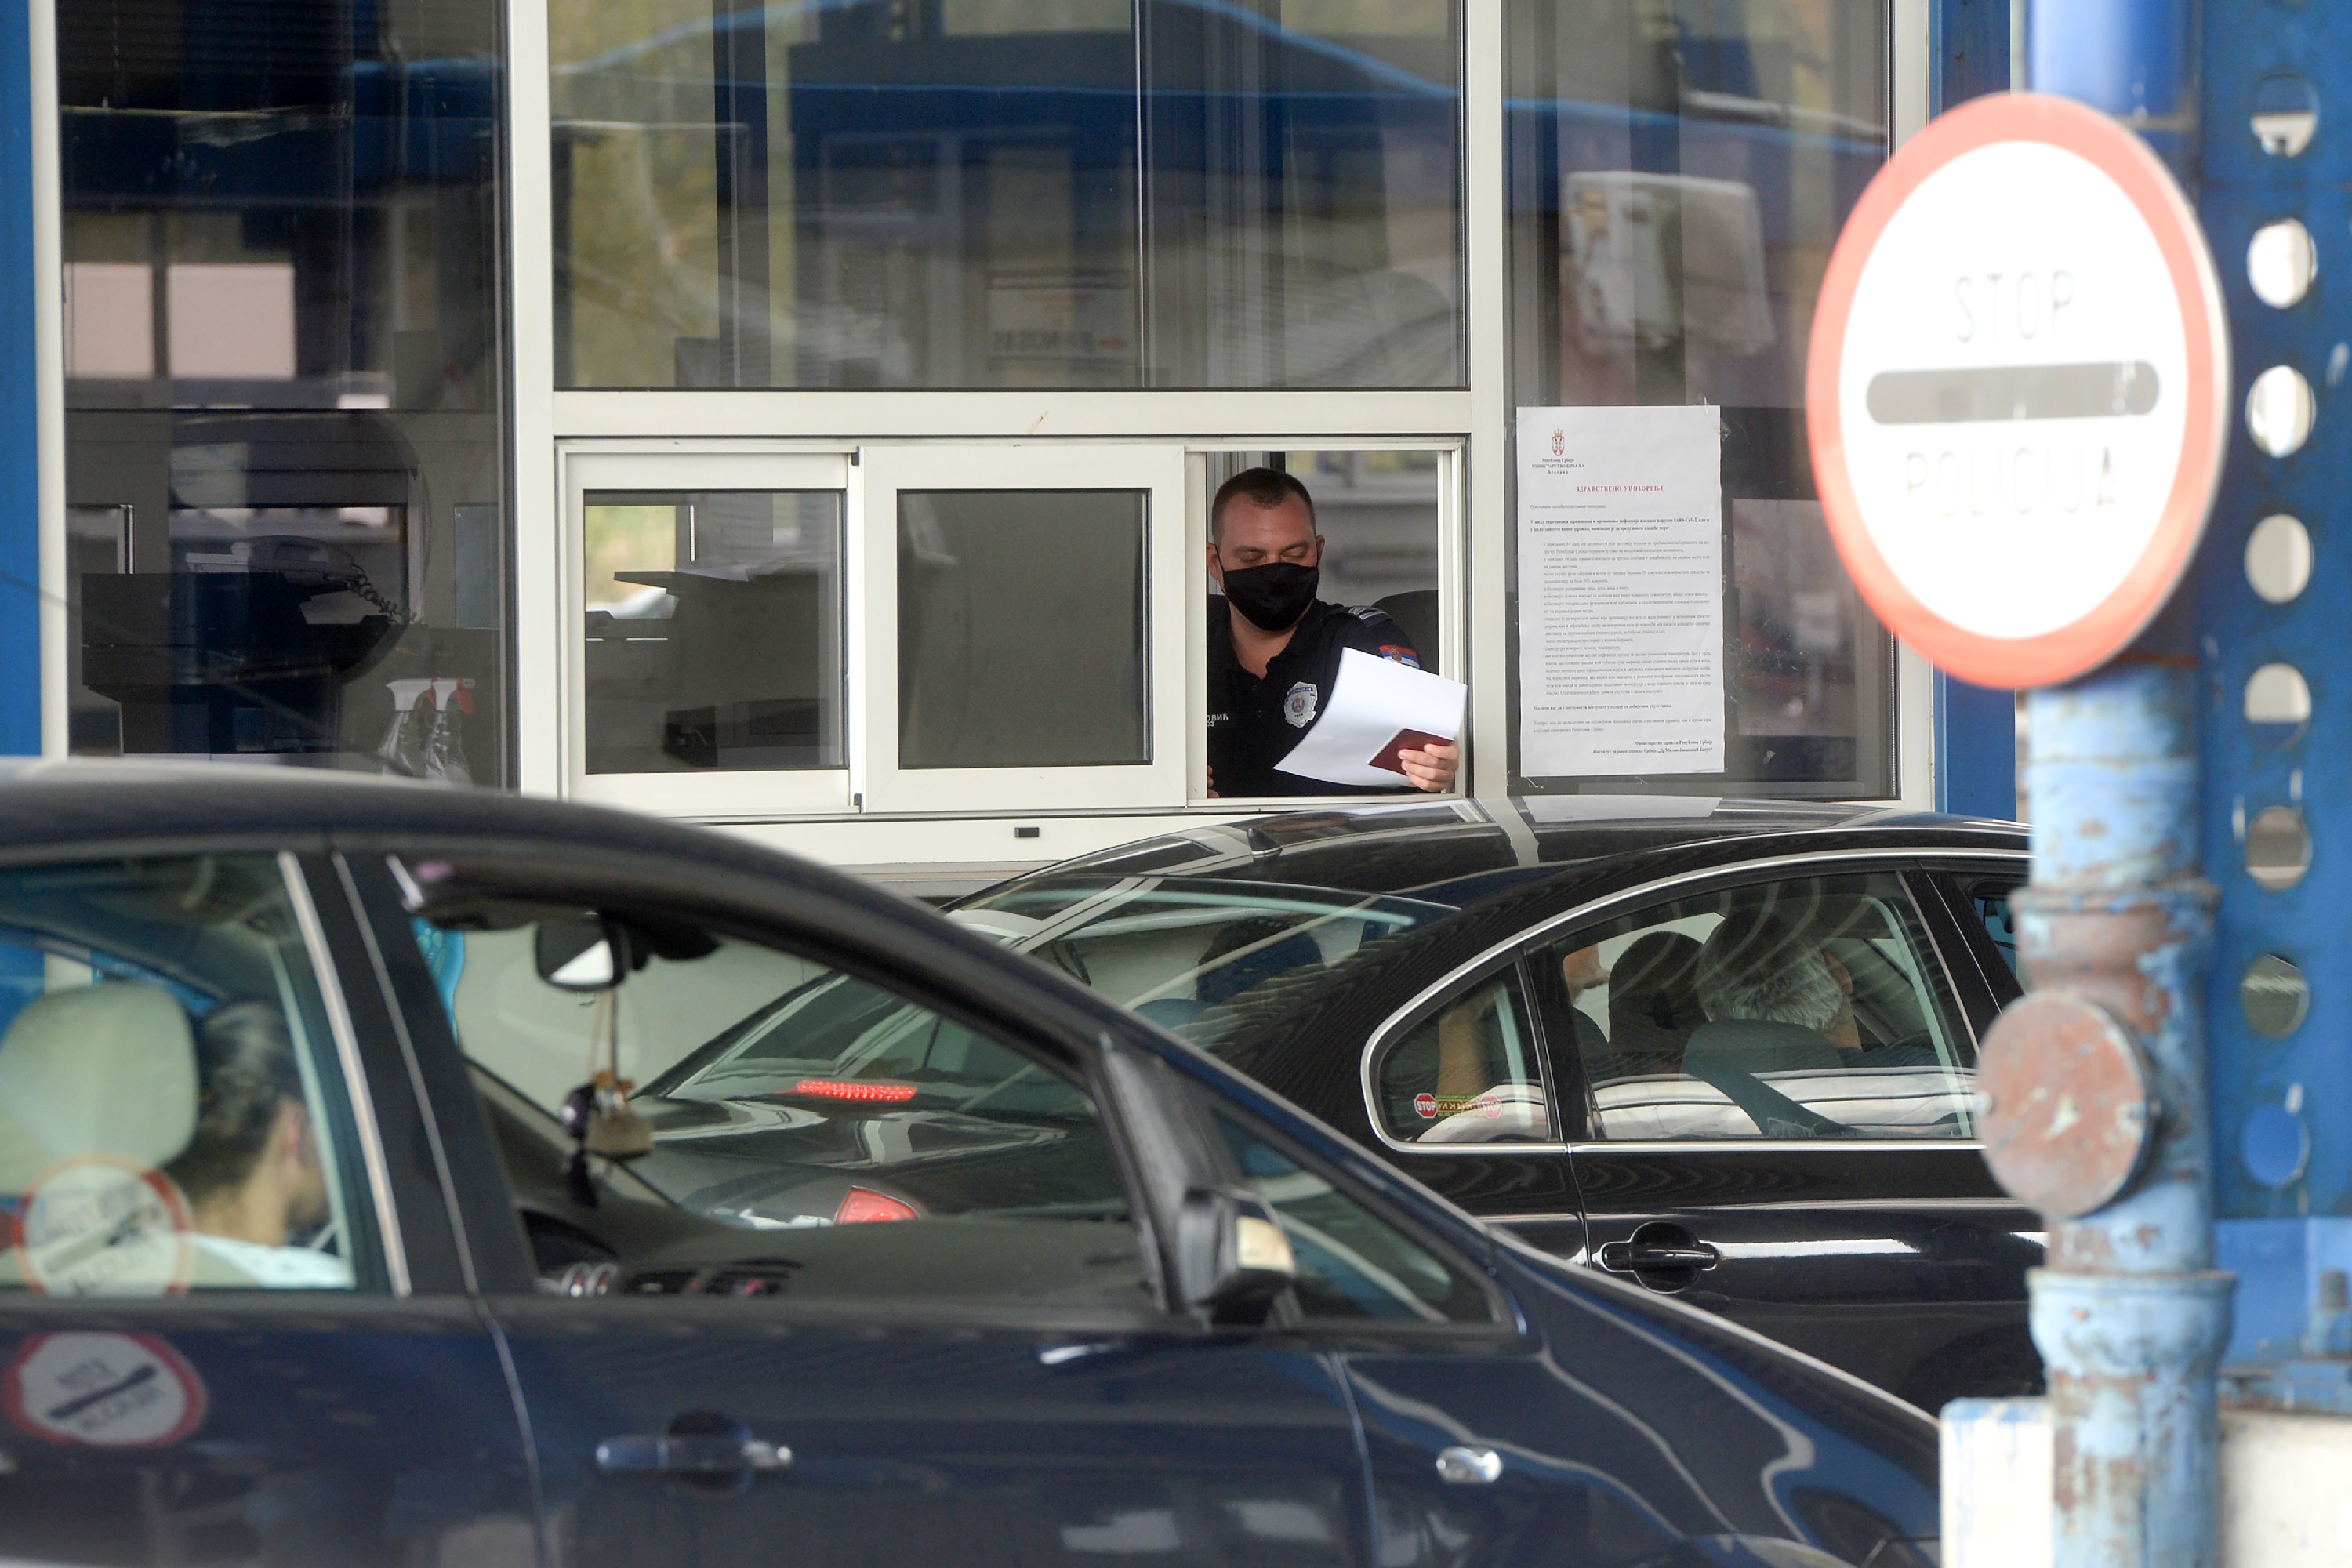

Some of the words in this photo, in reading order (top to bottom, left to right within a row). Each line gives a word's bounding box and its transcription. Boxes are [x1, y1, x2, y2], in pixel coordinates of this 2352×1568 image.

[1953, 269, 2075, 343] STOP
[1905, 445, 2117, 518] POLICIJA
[1417, 1100, 1436, 1112] STOP
